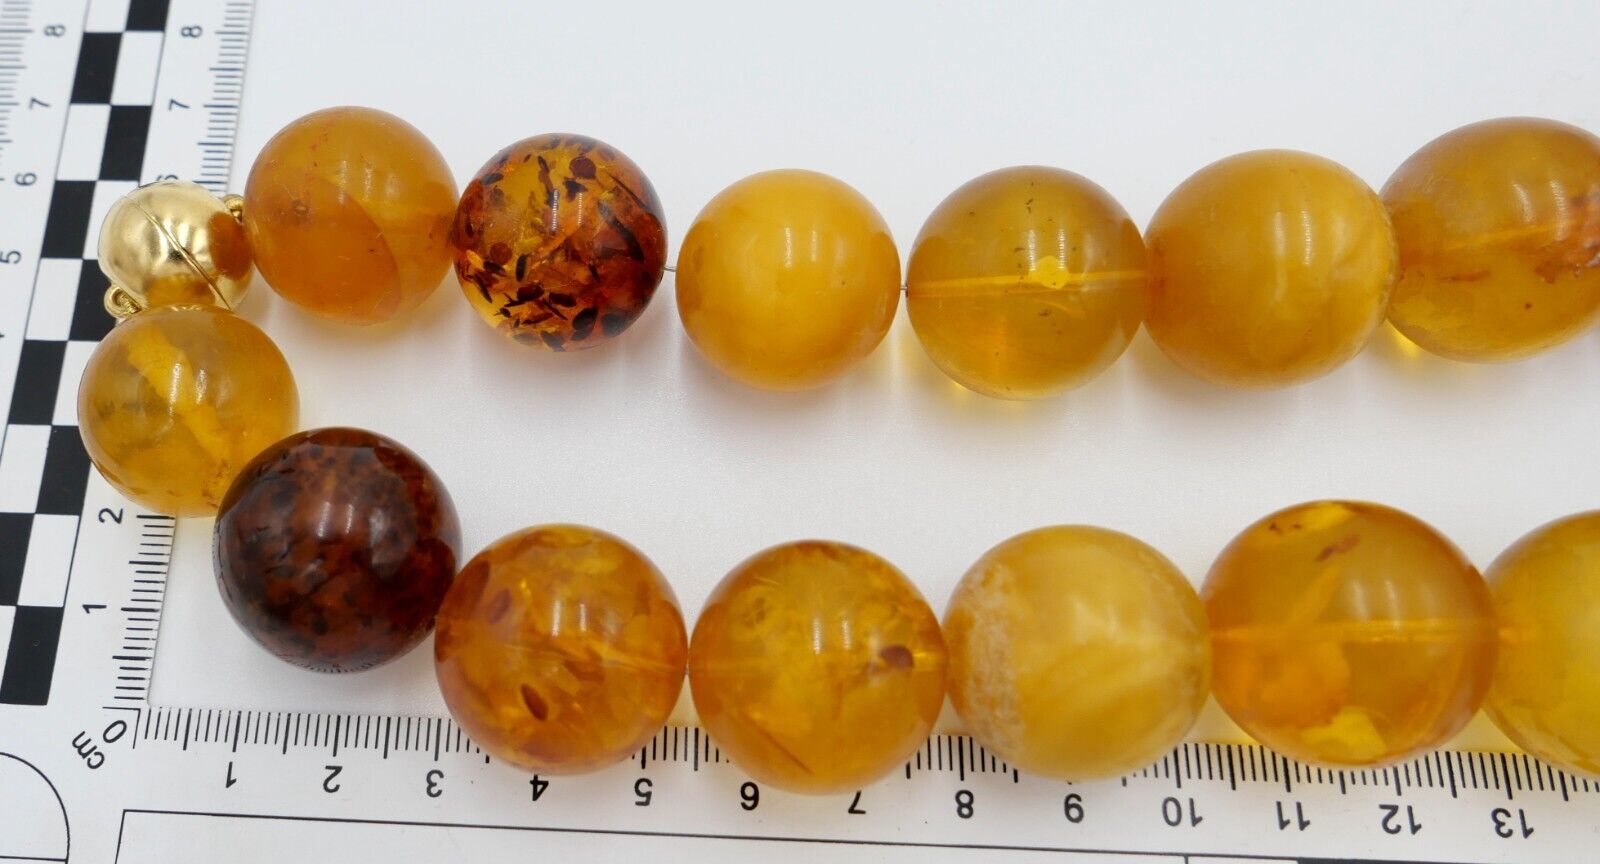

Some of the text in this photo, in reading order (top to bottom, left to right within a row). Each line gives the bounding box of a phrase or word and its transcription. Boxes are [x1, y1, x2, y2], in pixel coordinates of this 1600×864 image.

[43, 24, 66, 38] 8
[180, 25, 203, 39] 8
[29, 97, 50, 110] 7
[168, 98, 190, 111] 7
[15, 172, 37, 187] 6
[0, 250, 22, 265] 5
[98, 507, 124, 525] 2
[82, 604, 107, 616] 1
[102, 719, 128, 744] 0
[71, 727, 109, 770] cm
[225, 761, 238, 789] 1
[322, 765, 343, 794] 2
[425, 769, 445, 798] 3
[529, 774, 550, 802] 4
[633, 777, 653, 807] 5
[740, 781, 760, 811] 6
[847, 789, 867, 815] 7
[954, 789, 975, 819] 8
[1063, 792, 1084, 824] 9
[1161, 796, 1204, 828] 10
[1275, 800, 1311, 832] 11
[1378, 804, 1422, 835] 12
[1491, 807, 1535, 839] 13
